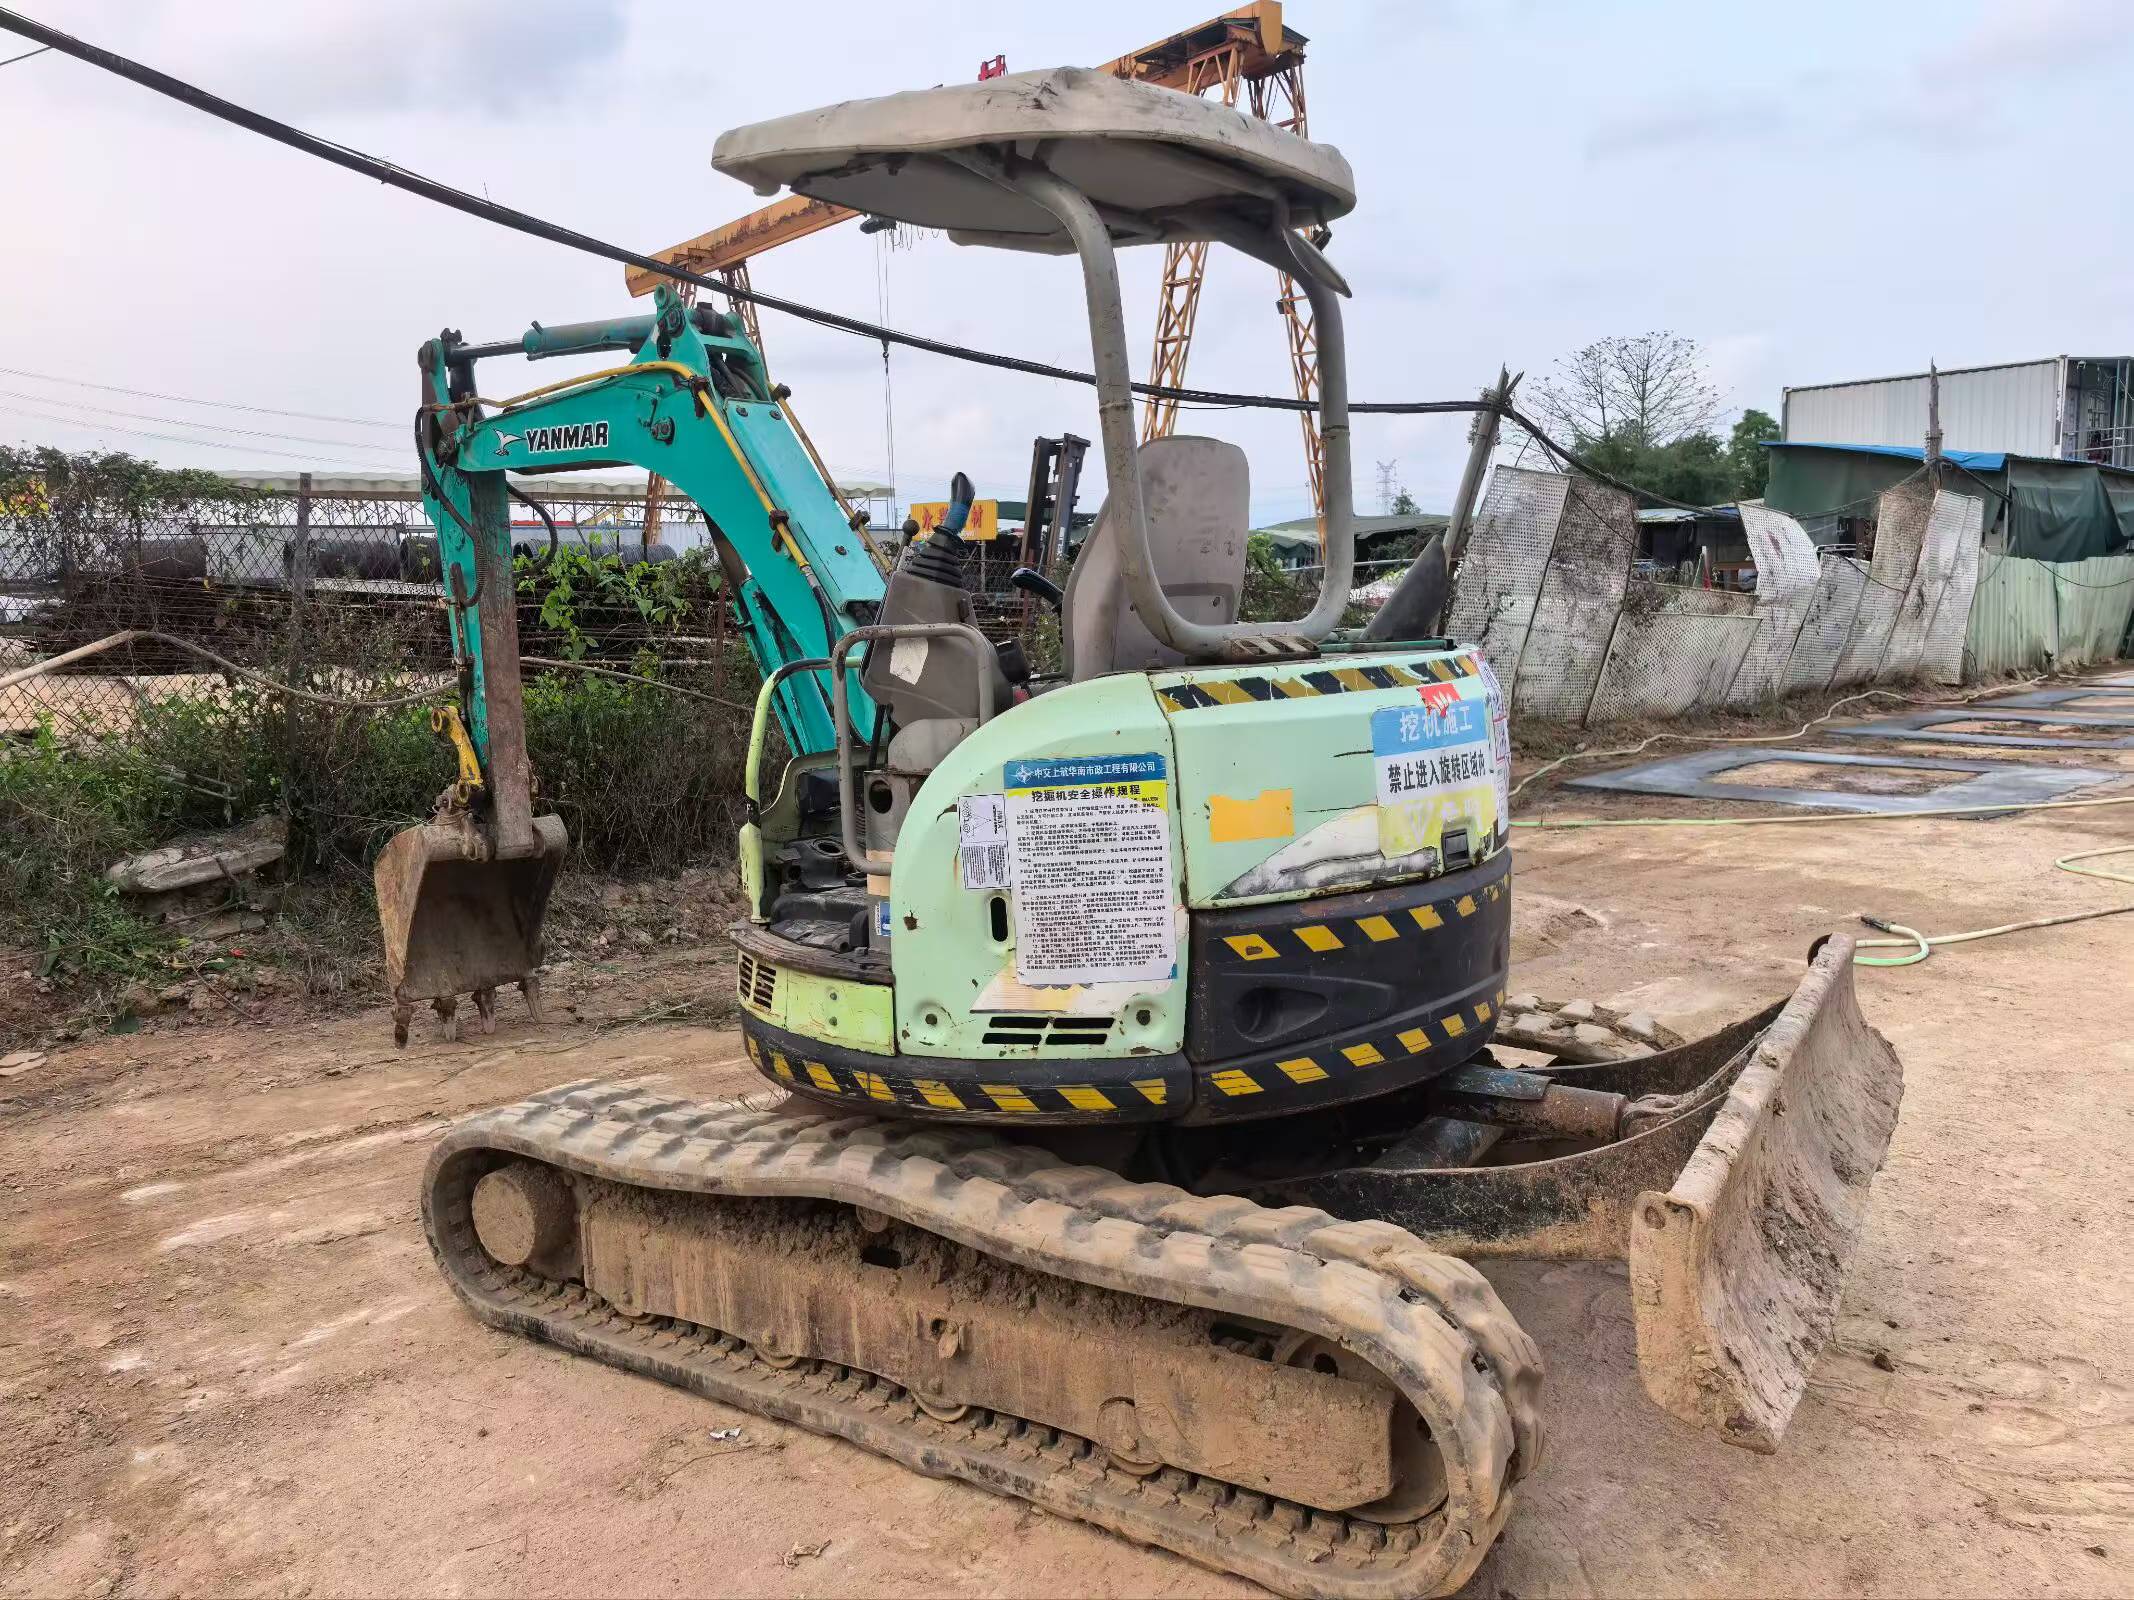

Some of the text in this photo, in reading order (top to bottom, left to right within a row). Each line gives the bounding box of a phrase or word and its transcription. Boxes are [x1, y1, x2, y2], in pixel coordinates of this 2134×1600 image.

[525, 420, 609, 453] YANMAR
[1400, 705, 1473, 743] 挖机施工
[1387, 749, 1486, 794] 禁止进入旋转区域内
[1031, 784, 1142, 803] 挖掘机安全操作规程
